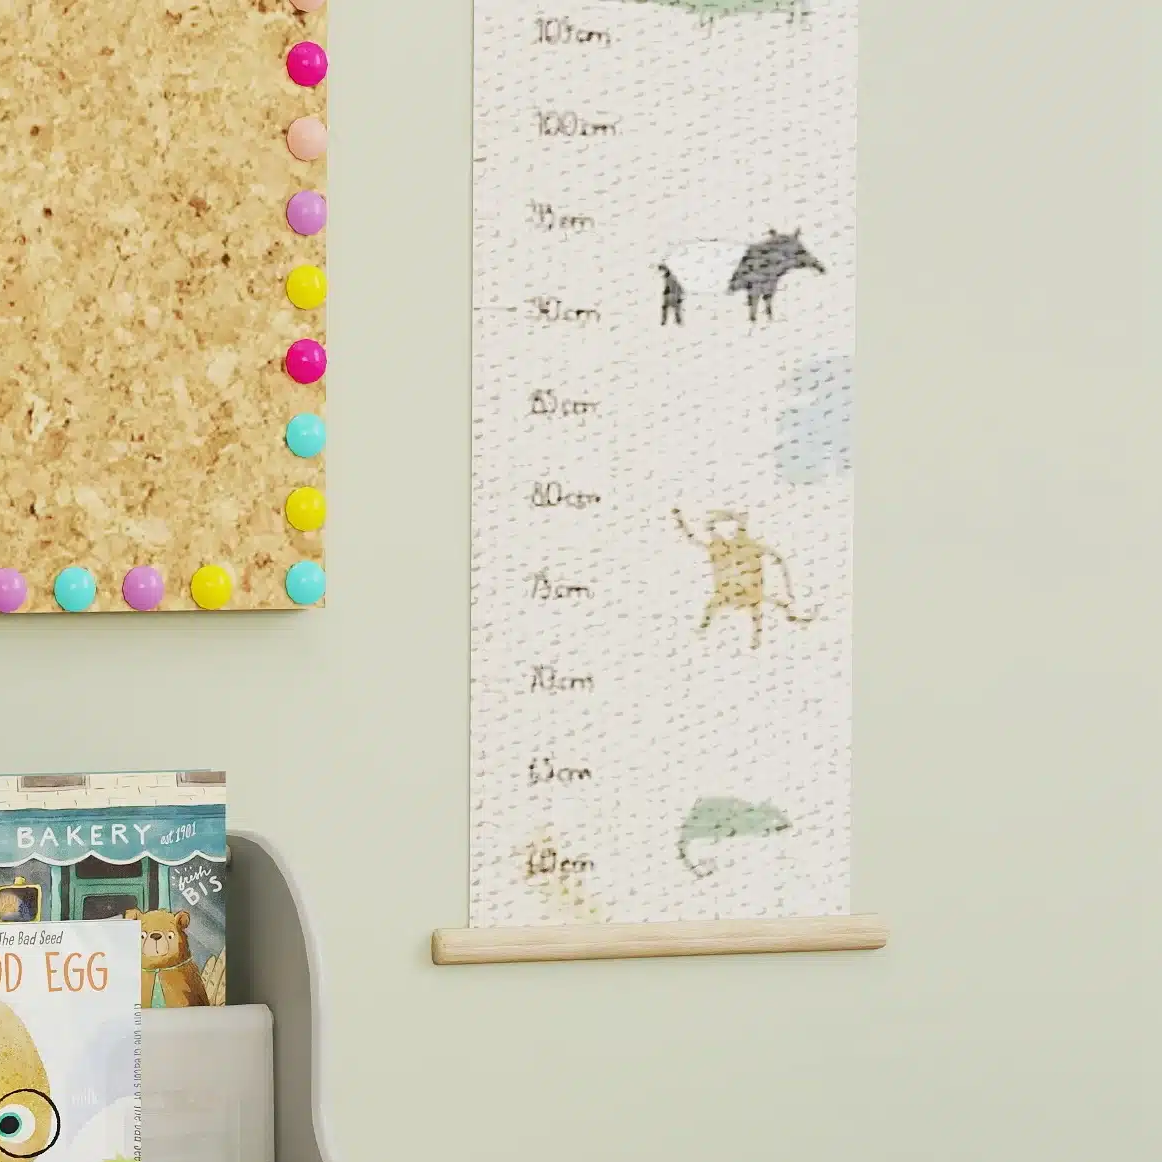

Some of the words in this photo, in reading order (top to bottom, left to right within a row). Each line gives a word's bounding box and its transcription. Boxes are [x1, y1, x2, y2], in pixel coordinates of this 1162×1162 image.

[17, 823, 152, 848] BAKERY
[178, 867, 212, 890] fresh
[181, 875, 223, 906] BIS
[18, 931, 37, 946] Bad
[39, 930, 63, 945] Seed
[45, 951, 108, 993] EGG
